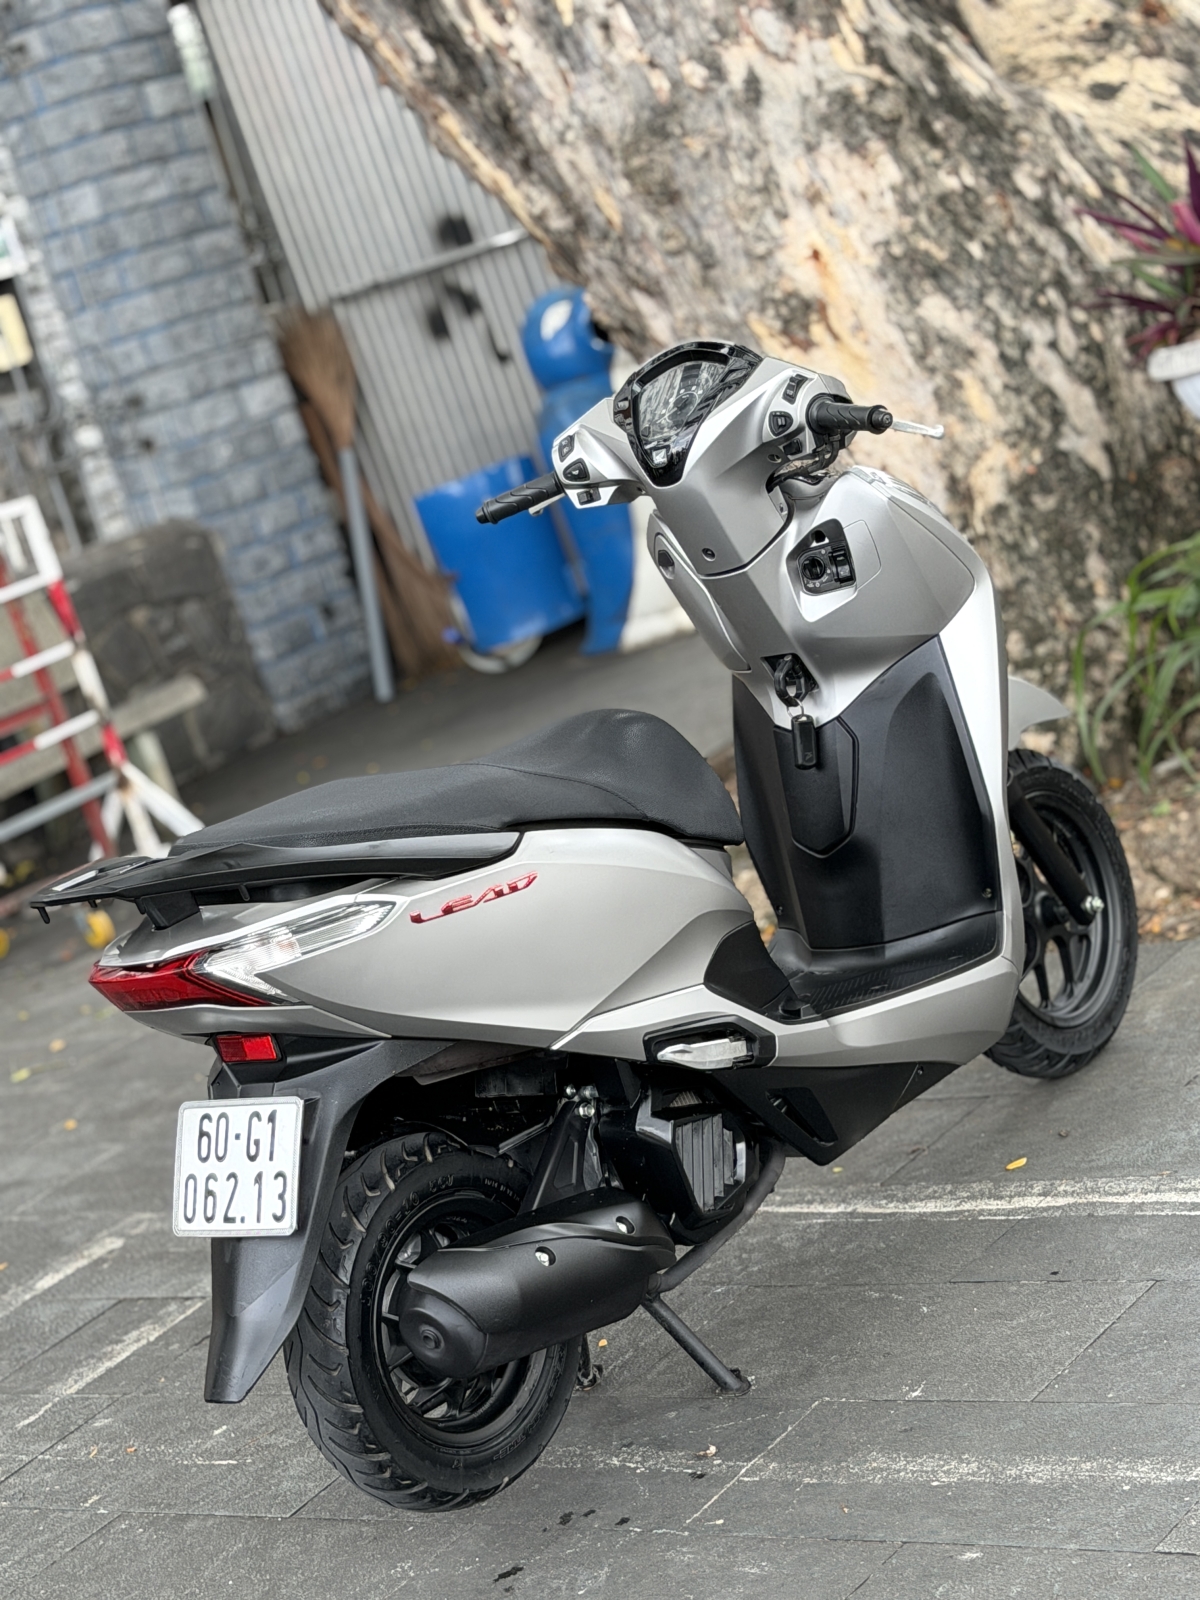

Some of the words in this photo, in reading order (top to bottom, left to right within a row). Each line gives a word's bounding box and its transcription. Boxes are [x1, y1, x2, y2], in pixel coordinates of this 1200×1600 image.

[409, 871, 538, 924] LEAD
[197, 1109, 278, 1163] 60-G1
[183, 1170, 288, 1224] 062.13
